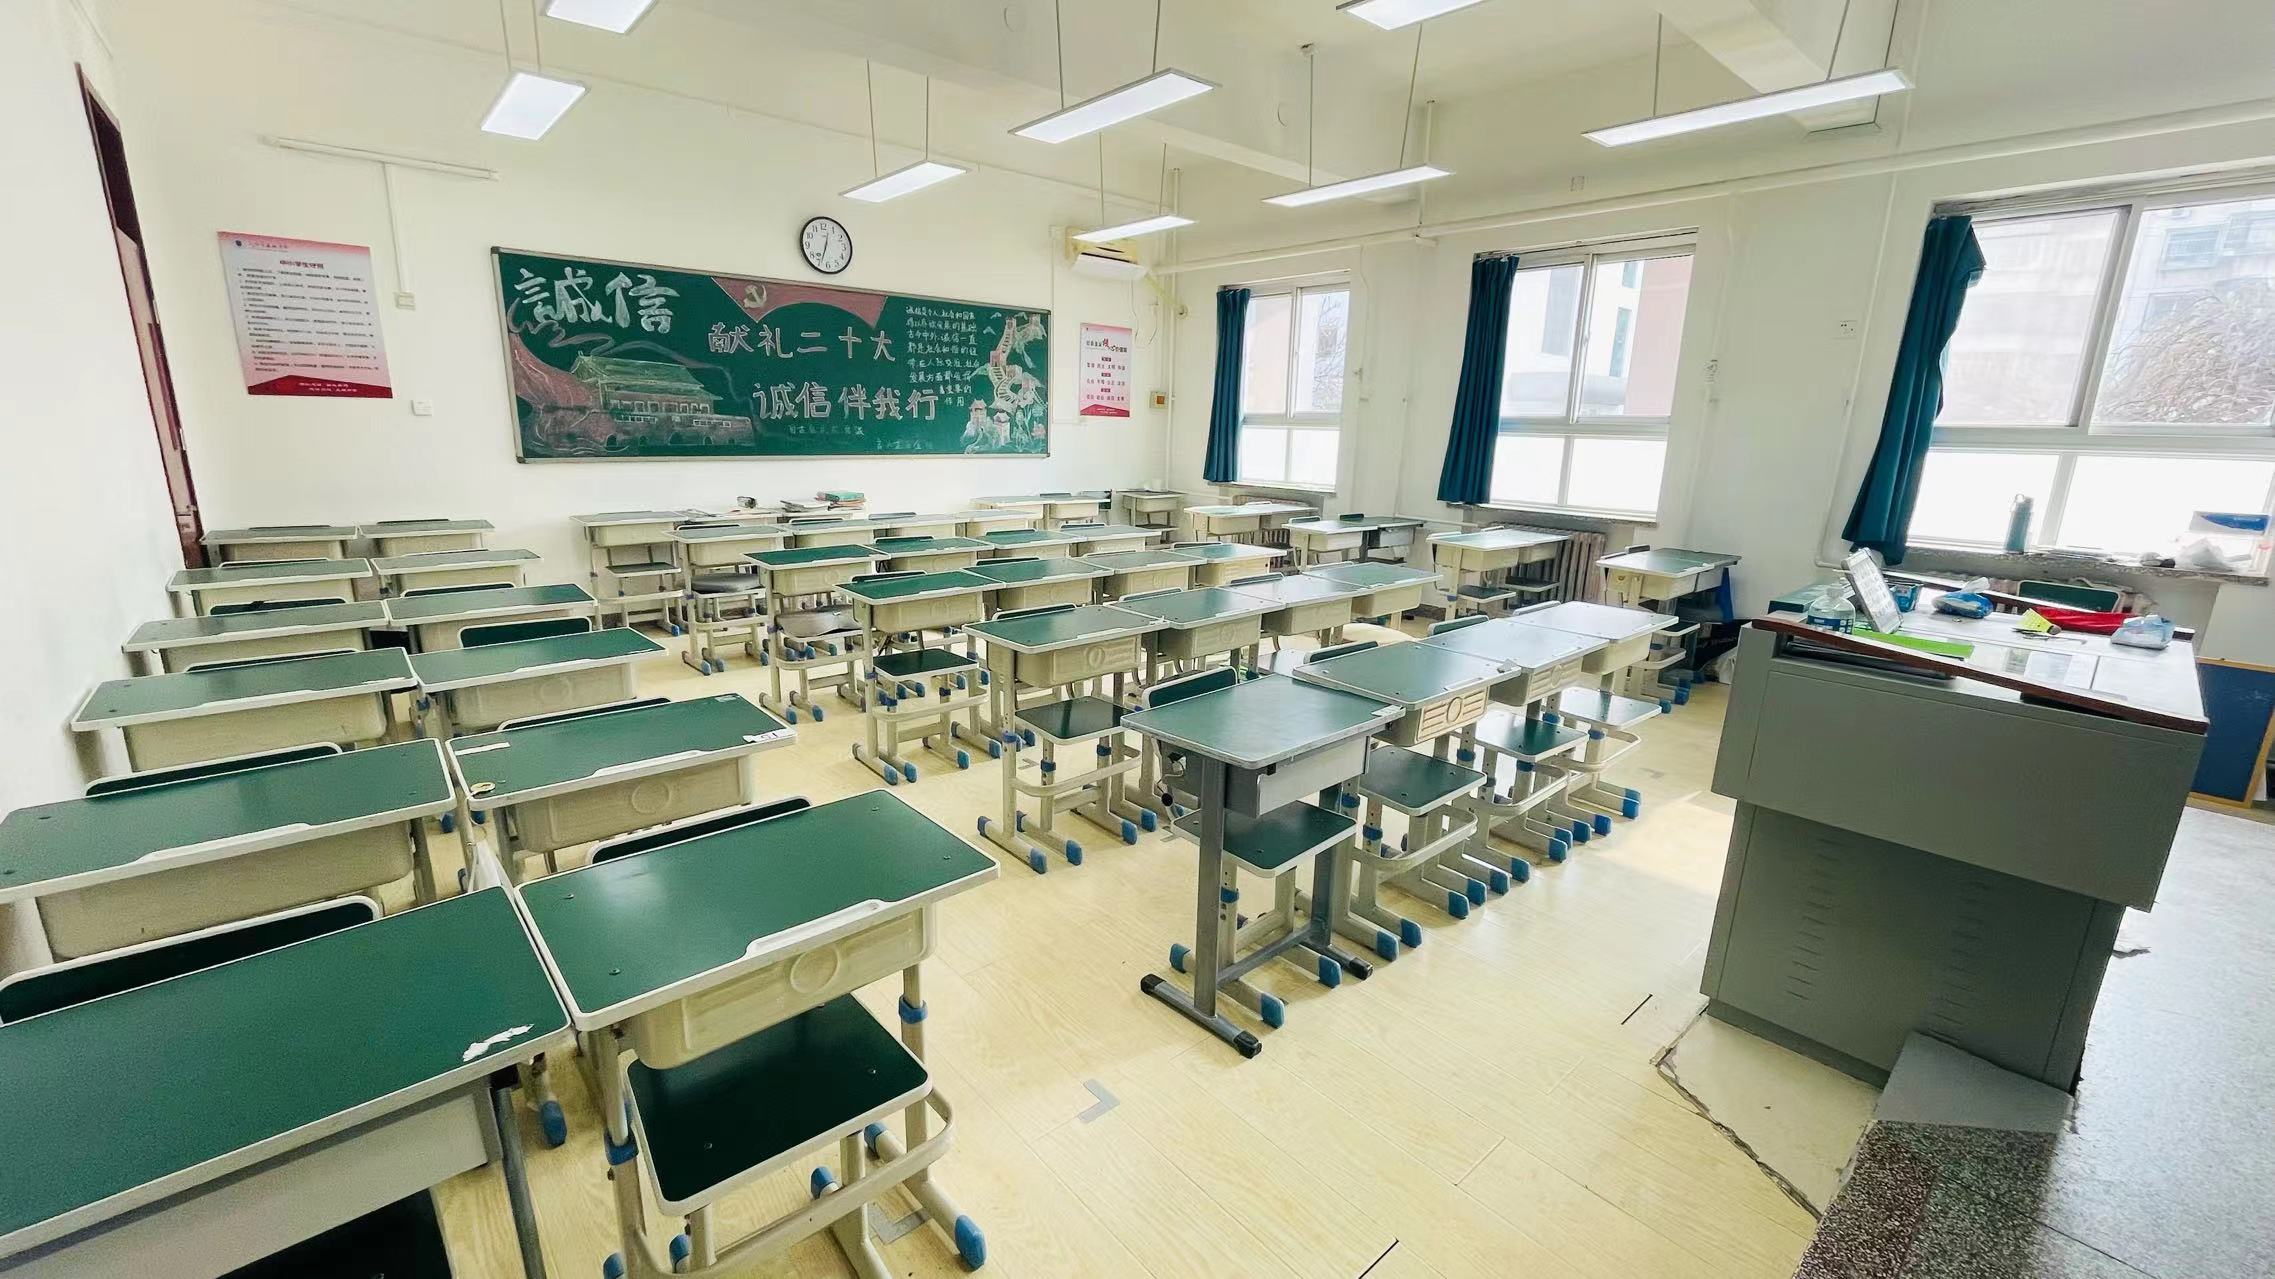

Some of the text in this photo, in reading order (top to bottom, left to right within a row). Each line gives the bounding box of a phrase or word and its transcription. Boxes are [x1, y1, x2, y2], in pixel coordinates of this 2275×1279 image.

[707, 321, 896, 362] 献礼二十大
[752, 381, 939, 421] 诚信伴我行
